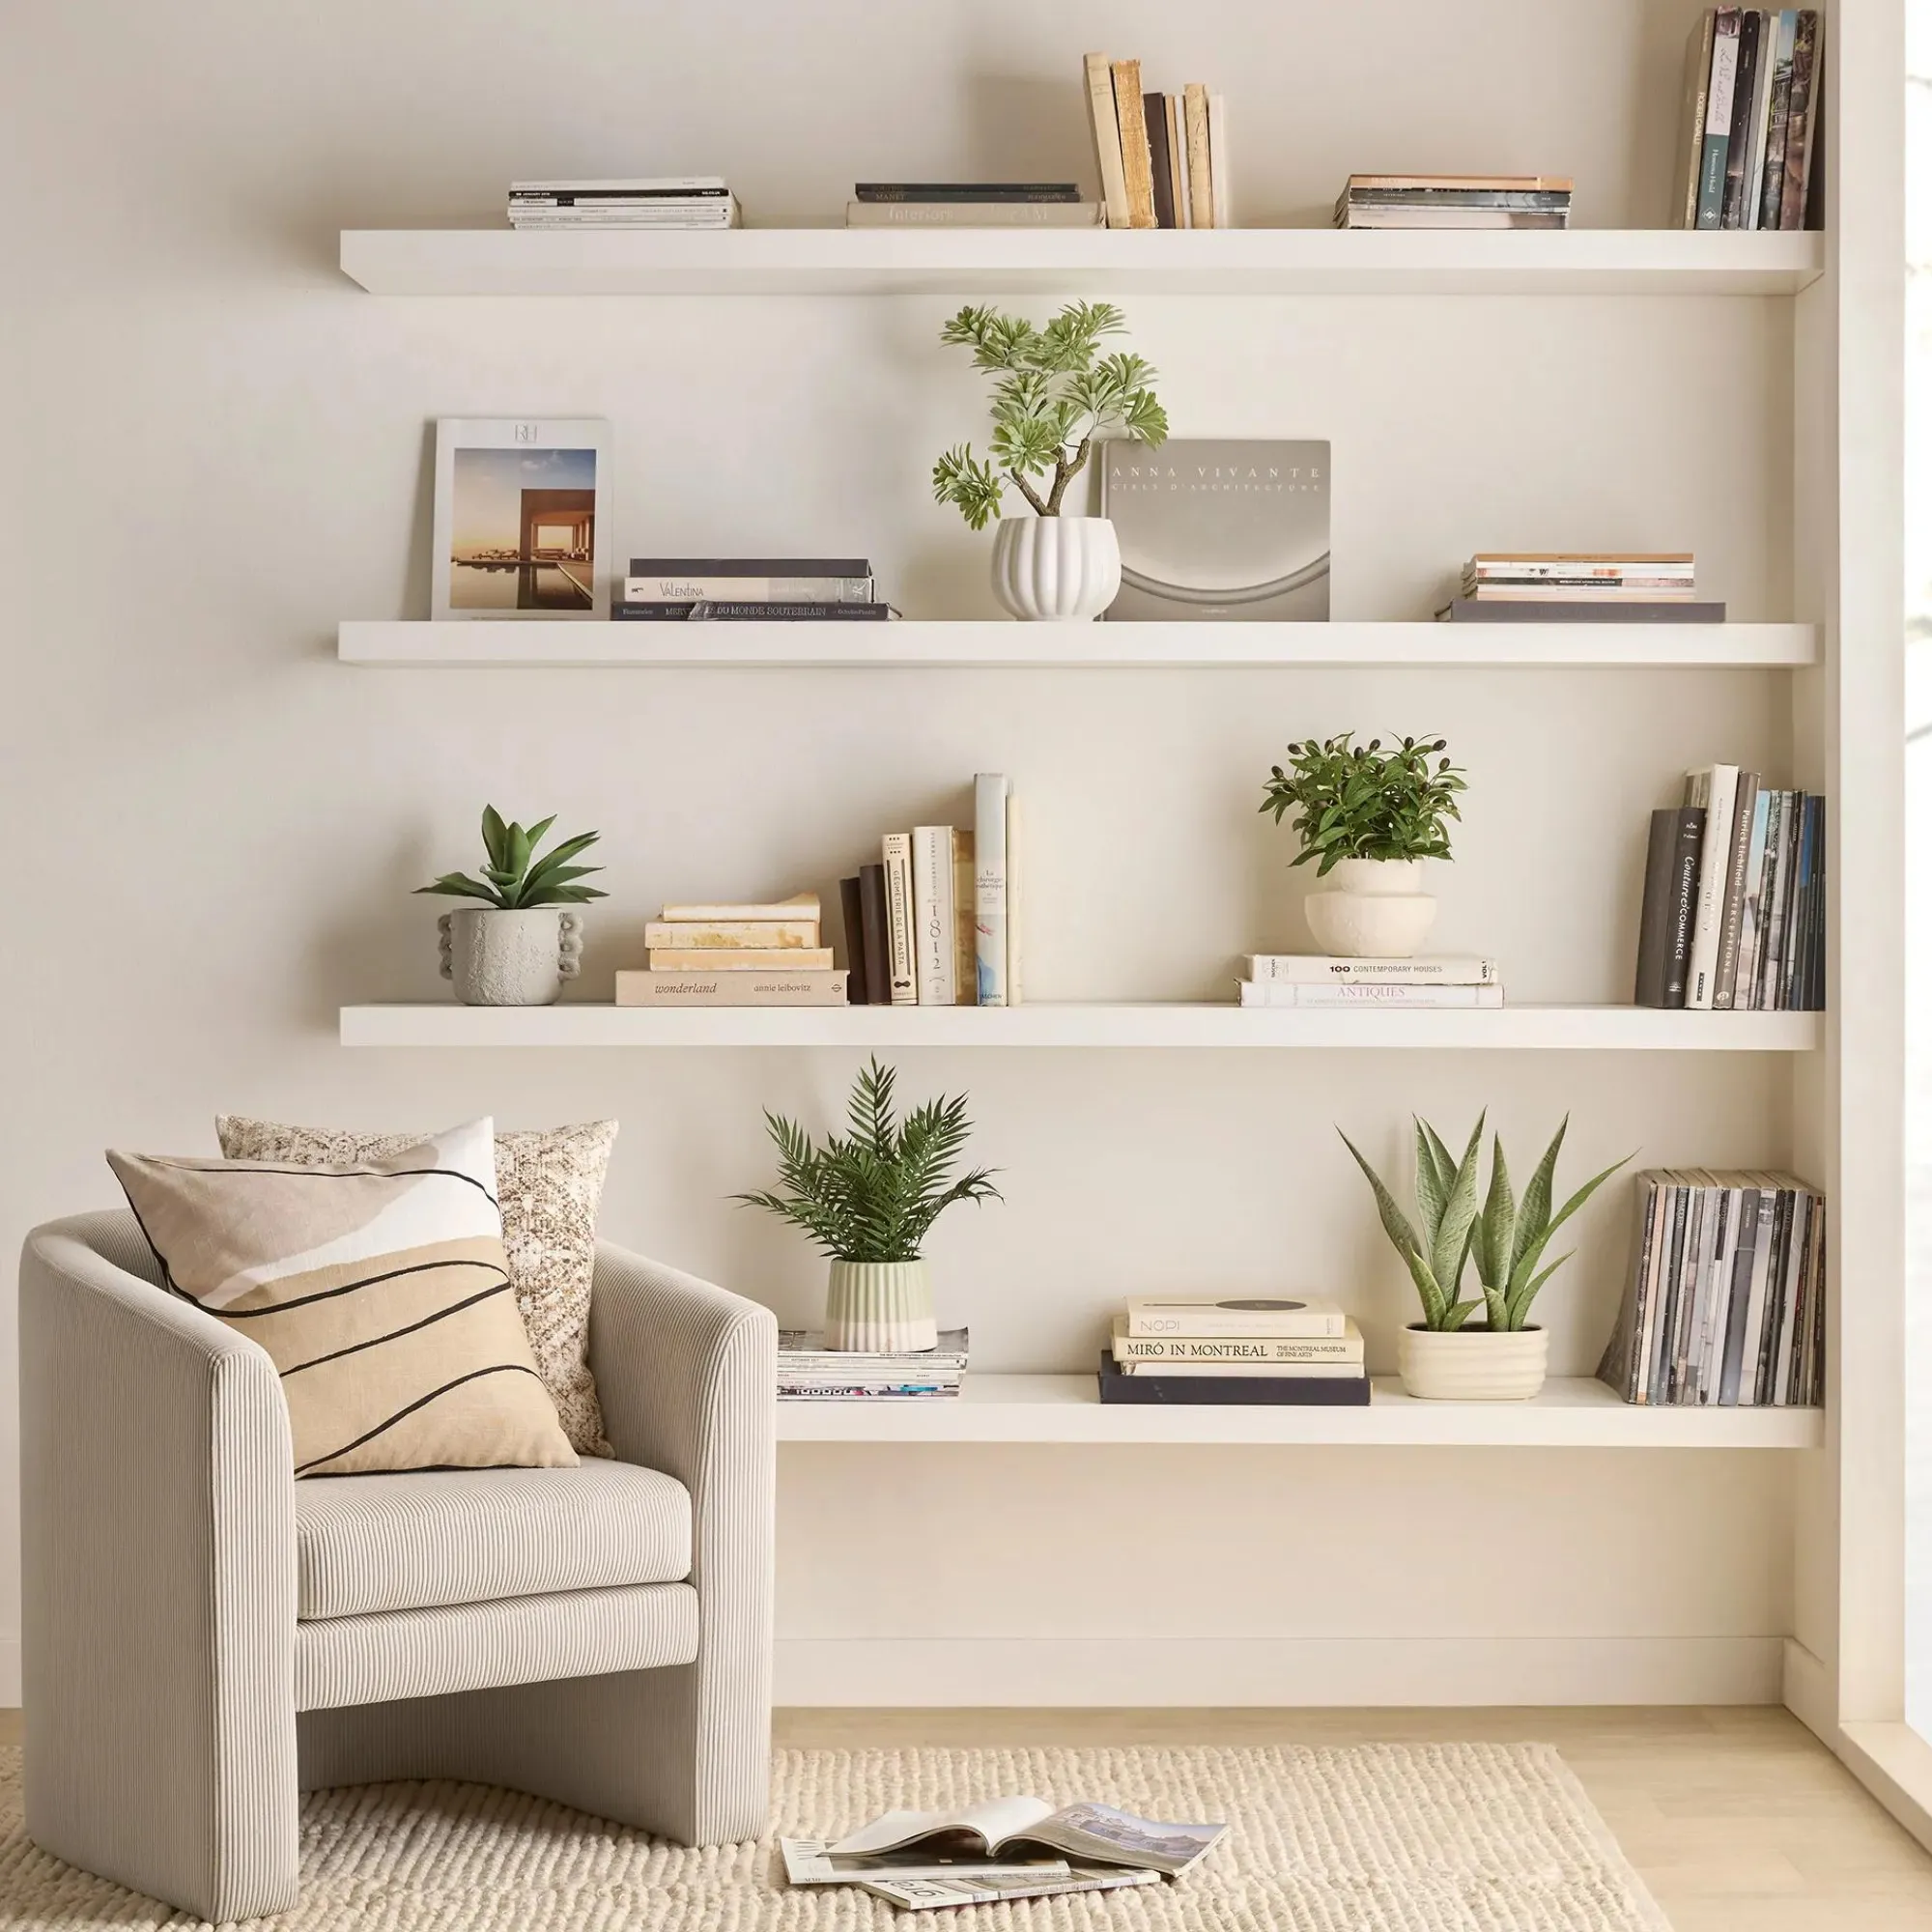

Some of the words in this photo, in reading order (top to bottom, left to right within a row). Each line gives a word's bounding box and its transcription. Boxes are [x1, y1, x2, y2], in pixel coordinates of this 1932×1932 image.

[1112, 467, 1176, 477] ANNA
[1198, 467, 1320, 478] VIVANTE
[717, 606, 729, 615] DU
[730, 606, 765, 615] MONDE
[1740, 810, 1750, 842] Patrick
[1734, 845, 1747, 886] Lichfield
[1681, 856, 1695, 898] Couture
[1674, 908, 1688, 960] COMMERCE
[655, 983, 717, 994] wonderland
[753, 983, 777, 992] annie
[777, 983, 810, 992] leibovitz
[1337, 986, 1406, 1001] ANTIQUES
[1140, 1320, 1179, 1331] NOPI
[1127, 1342, 1164, 1355] MIRÓ
[1171, 1344, 1185, 1355] IN
[1190, 1344, 1268, 1356] MONTREAL
